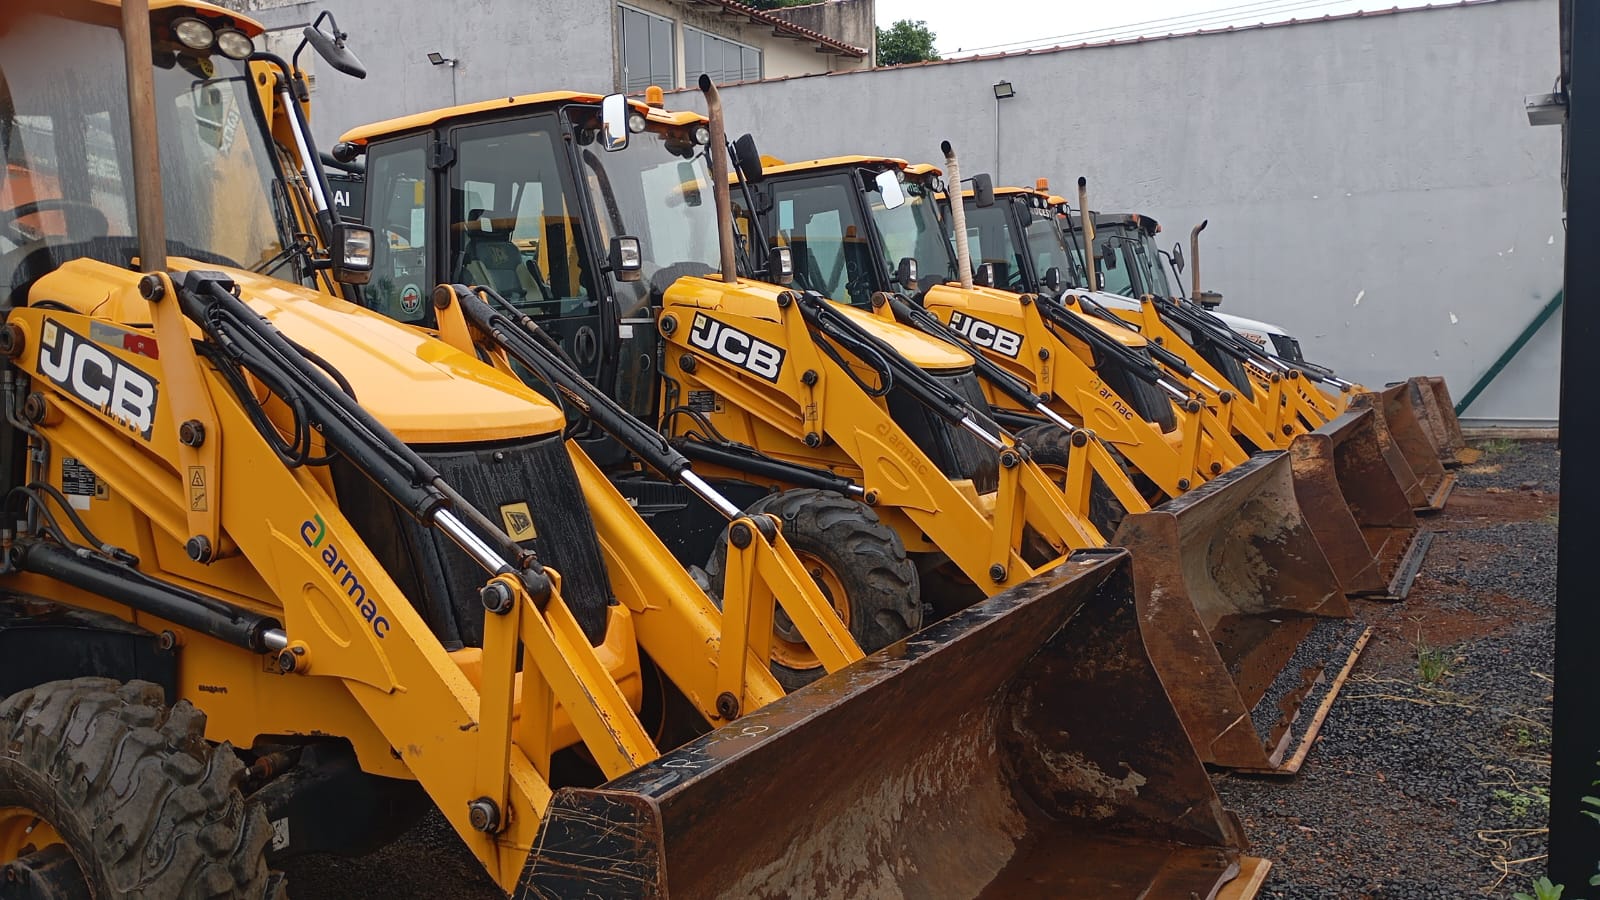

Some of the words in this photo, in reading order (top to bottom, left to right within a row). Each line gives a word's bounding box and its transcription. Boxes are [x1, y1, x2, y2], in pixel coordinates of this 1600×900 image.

[690, 315, 781, 379] JCB
[949, 312, 1021, 356] JCB
[41, 322, 154, 433] JCB
[888, 434, 928, 475] armac
[321, 543, 390, 639] armac
